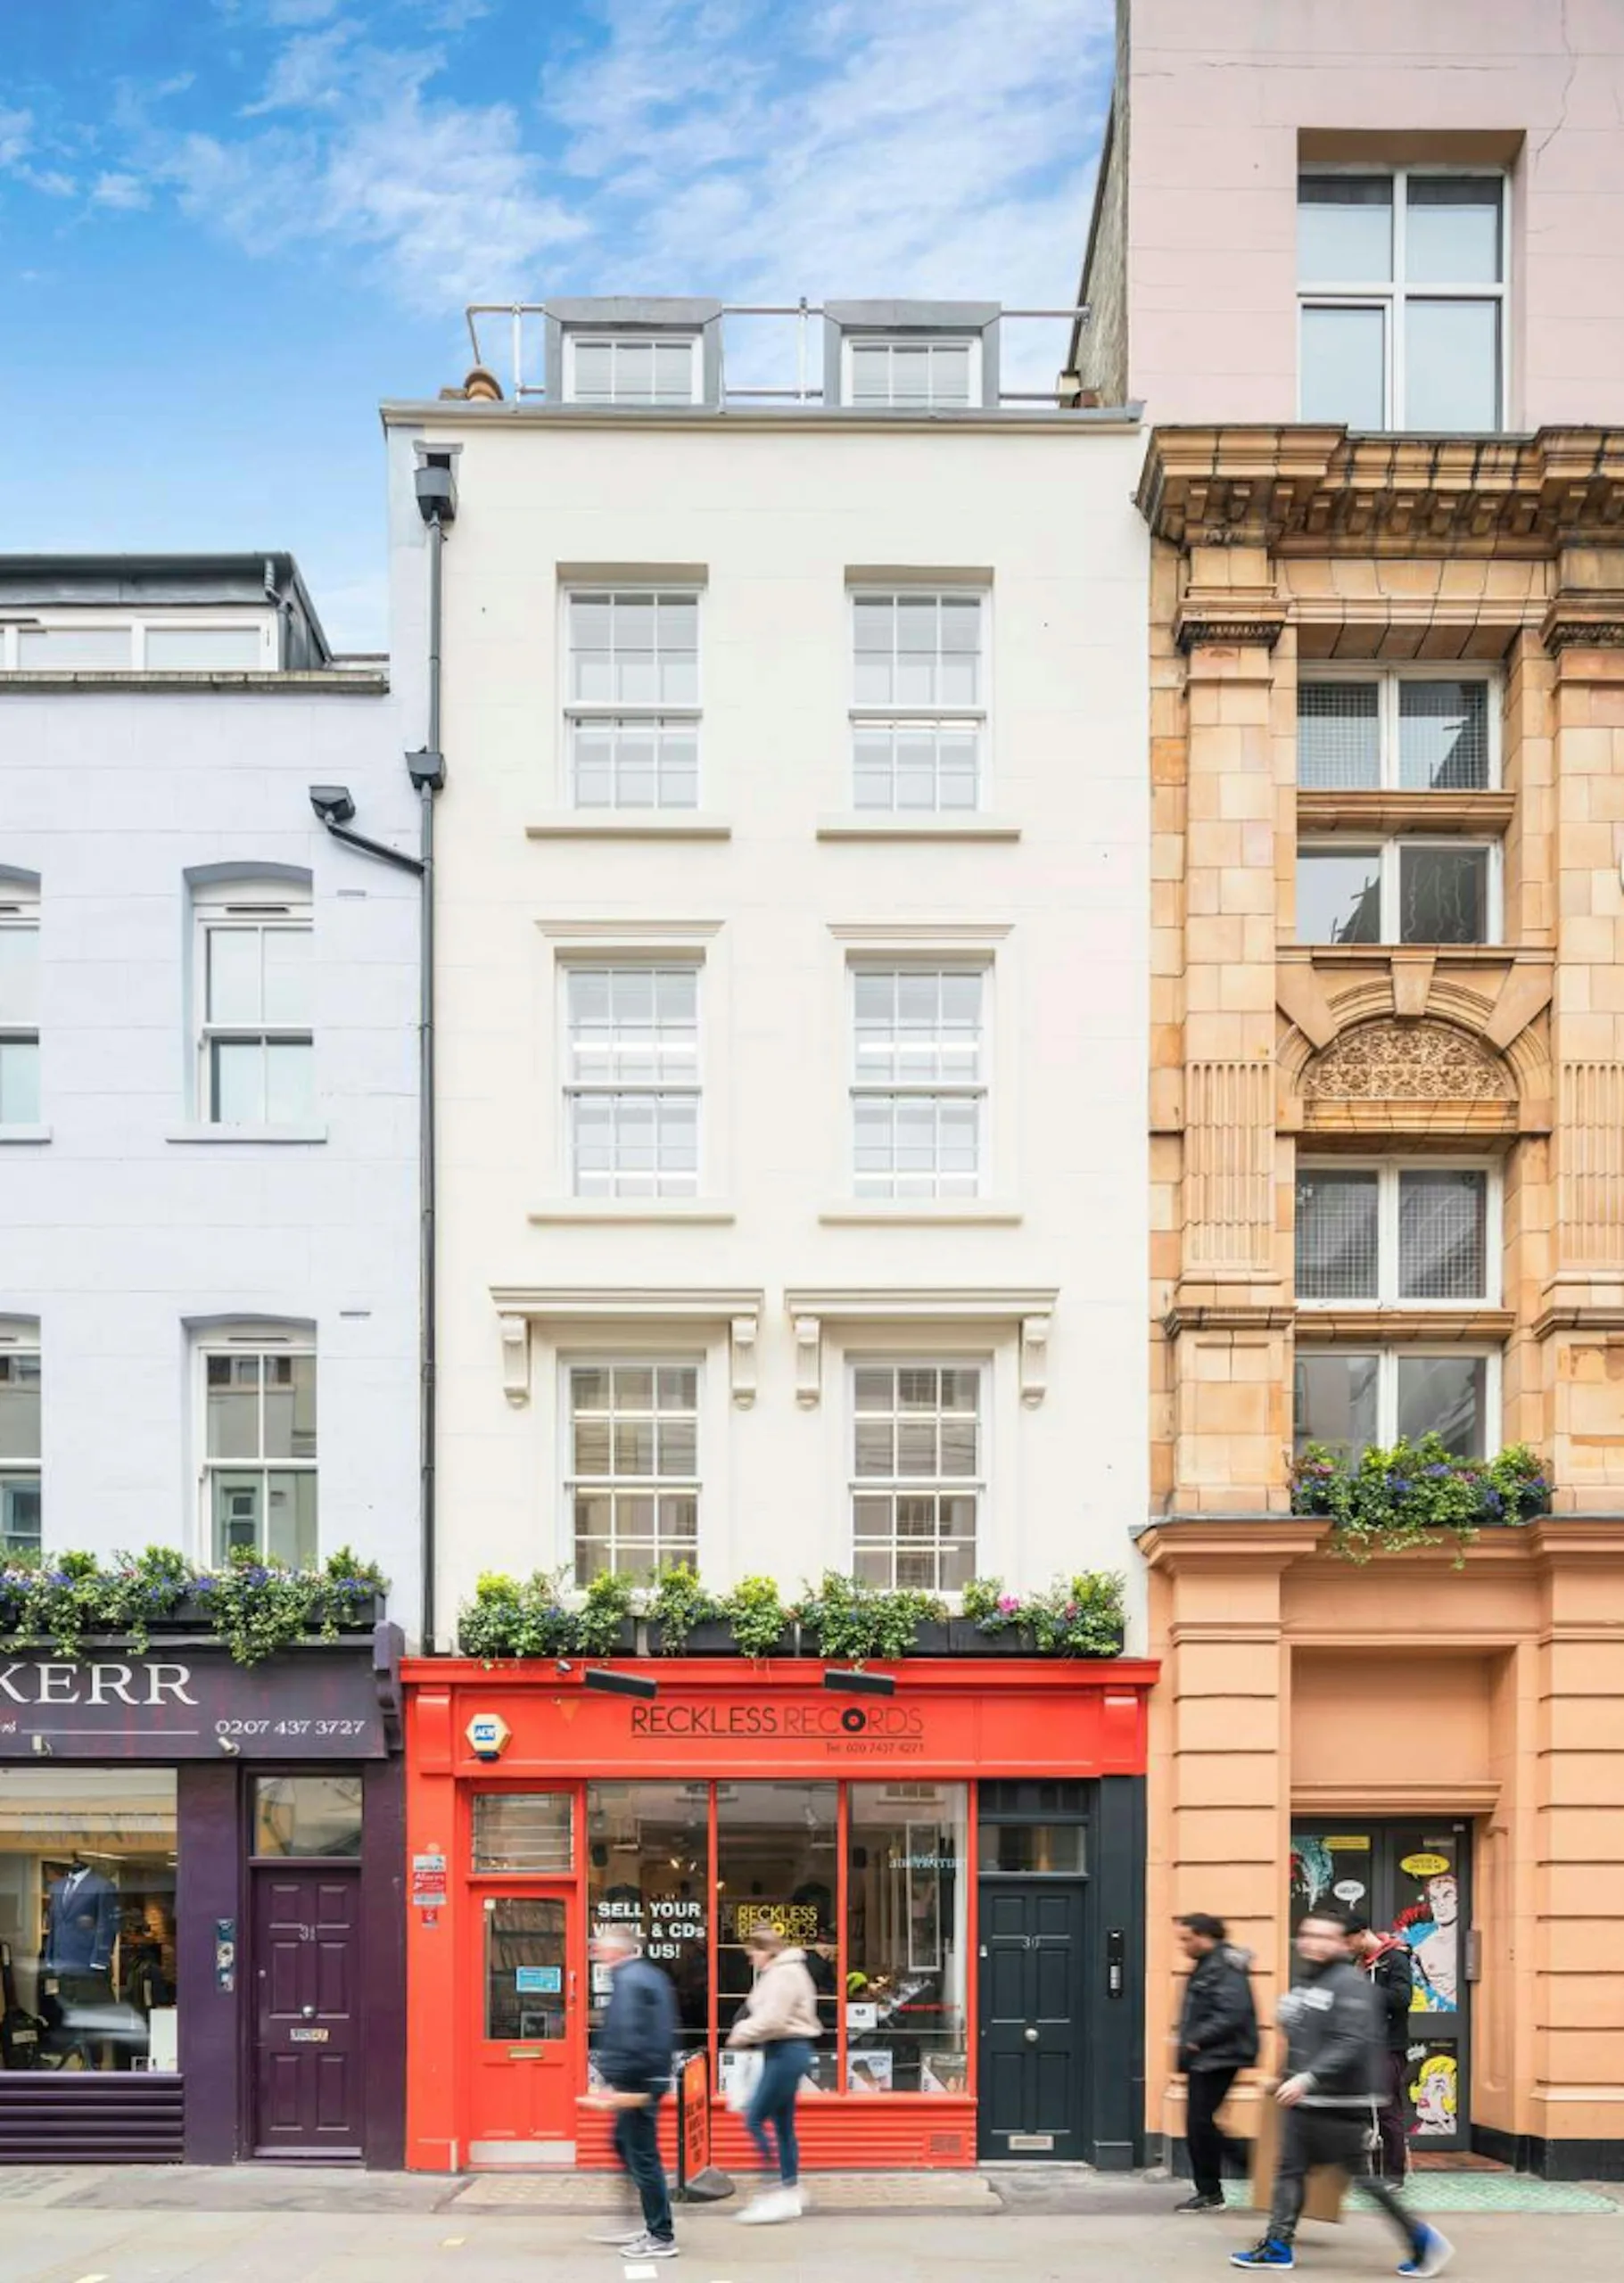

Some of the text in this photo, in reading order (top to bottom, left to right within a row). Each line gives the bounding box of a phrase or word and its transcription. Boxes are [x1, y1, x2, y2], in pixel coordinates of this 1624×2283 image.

[0, 1662, 199, 1705] KERR
[214, 1719, 366, 1735] 0207 437 3727
[631, 1705, 924, 1734] RECKLESS RECORDS
[598, 1901, 702, 1918] SELL YOUR
[738, 1905, 818, 1922] RECKLESS
[651, 1922, 664, 1938] &
[669, 1922, 706, 1938] CDs
[738, 1922, 818, 1939] REORDS
[1022, 1935, 1039, 1950] 30
[648, 1944, 681, 1959] US!
